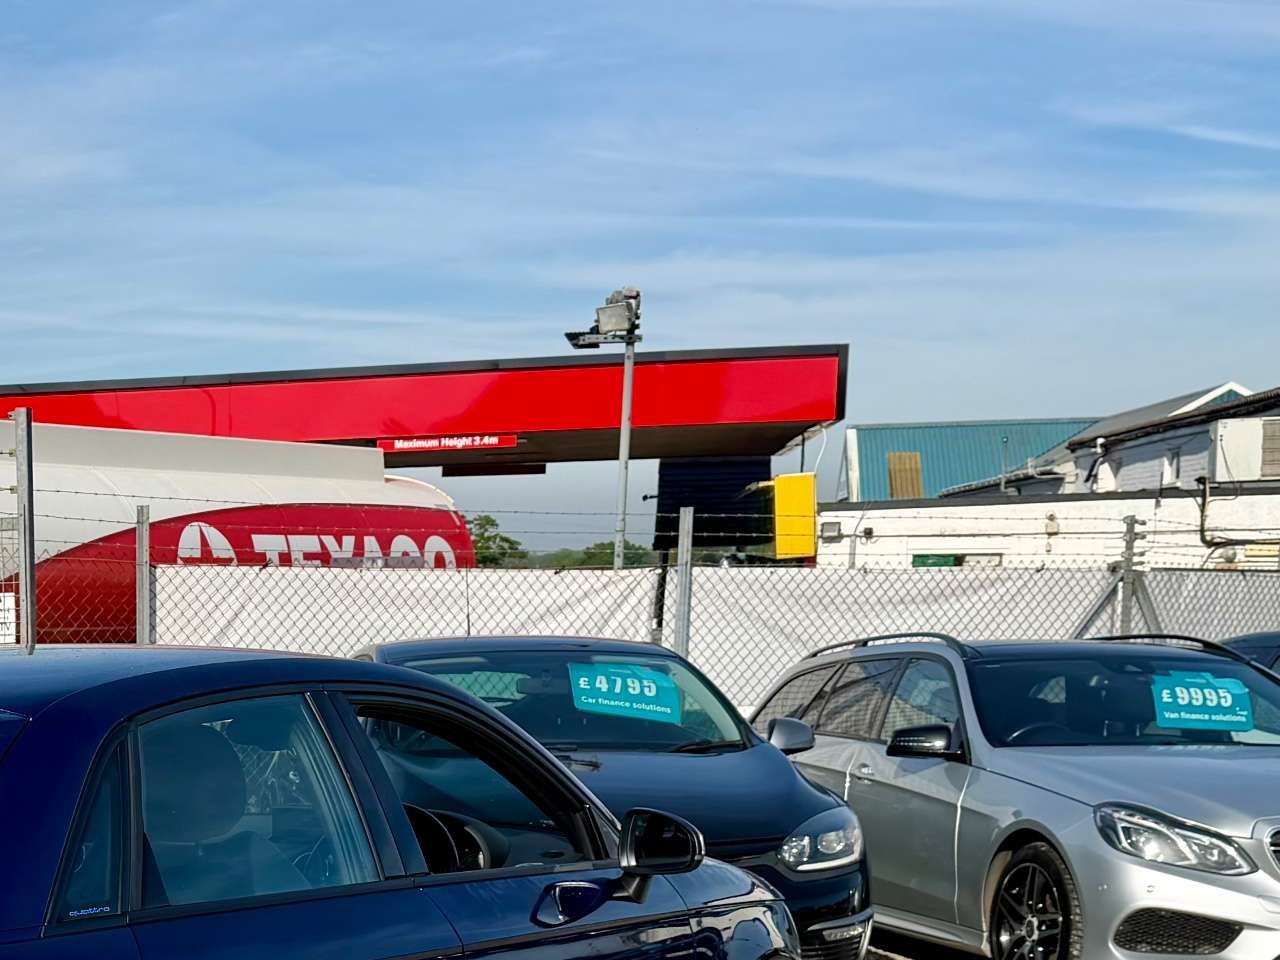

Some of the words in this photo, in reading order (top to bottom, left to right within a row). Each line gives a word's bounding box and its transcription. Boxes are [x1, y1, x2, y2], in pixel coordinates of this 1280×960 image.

[394, 439, 439, 449] Maximum
[440, 437, 472, 448] Height
[473, 436, 499, 446] 3.4m
[581, 696, 596, 704] Car
[598, 698, 631, 708] finance
[632, 702, 672, 714] solutions
[1163, 711, 1180, 719] Van
[1180, 712, 1210, 720] finance
[1211, 714, 1247, 722] solutions
